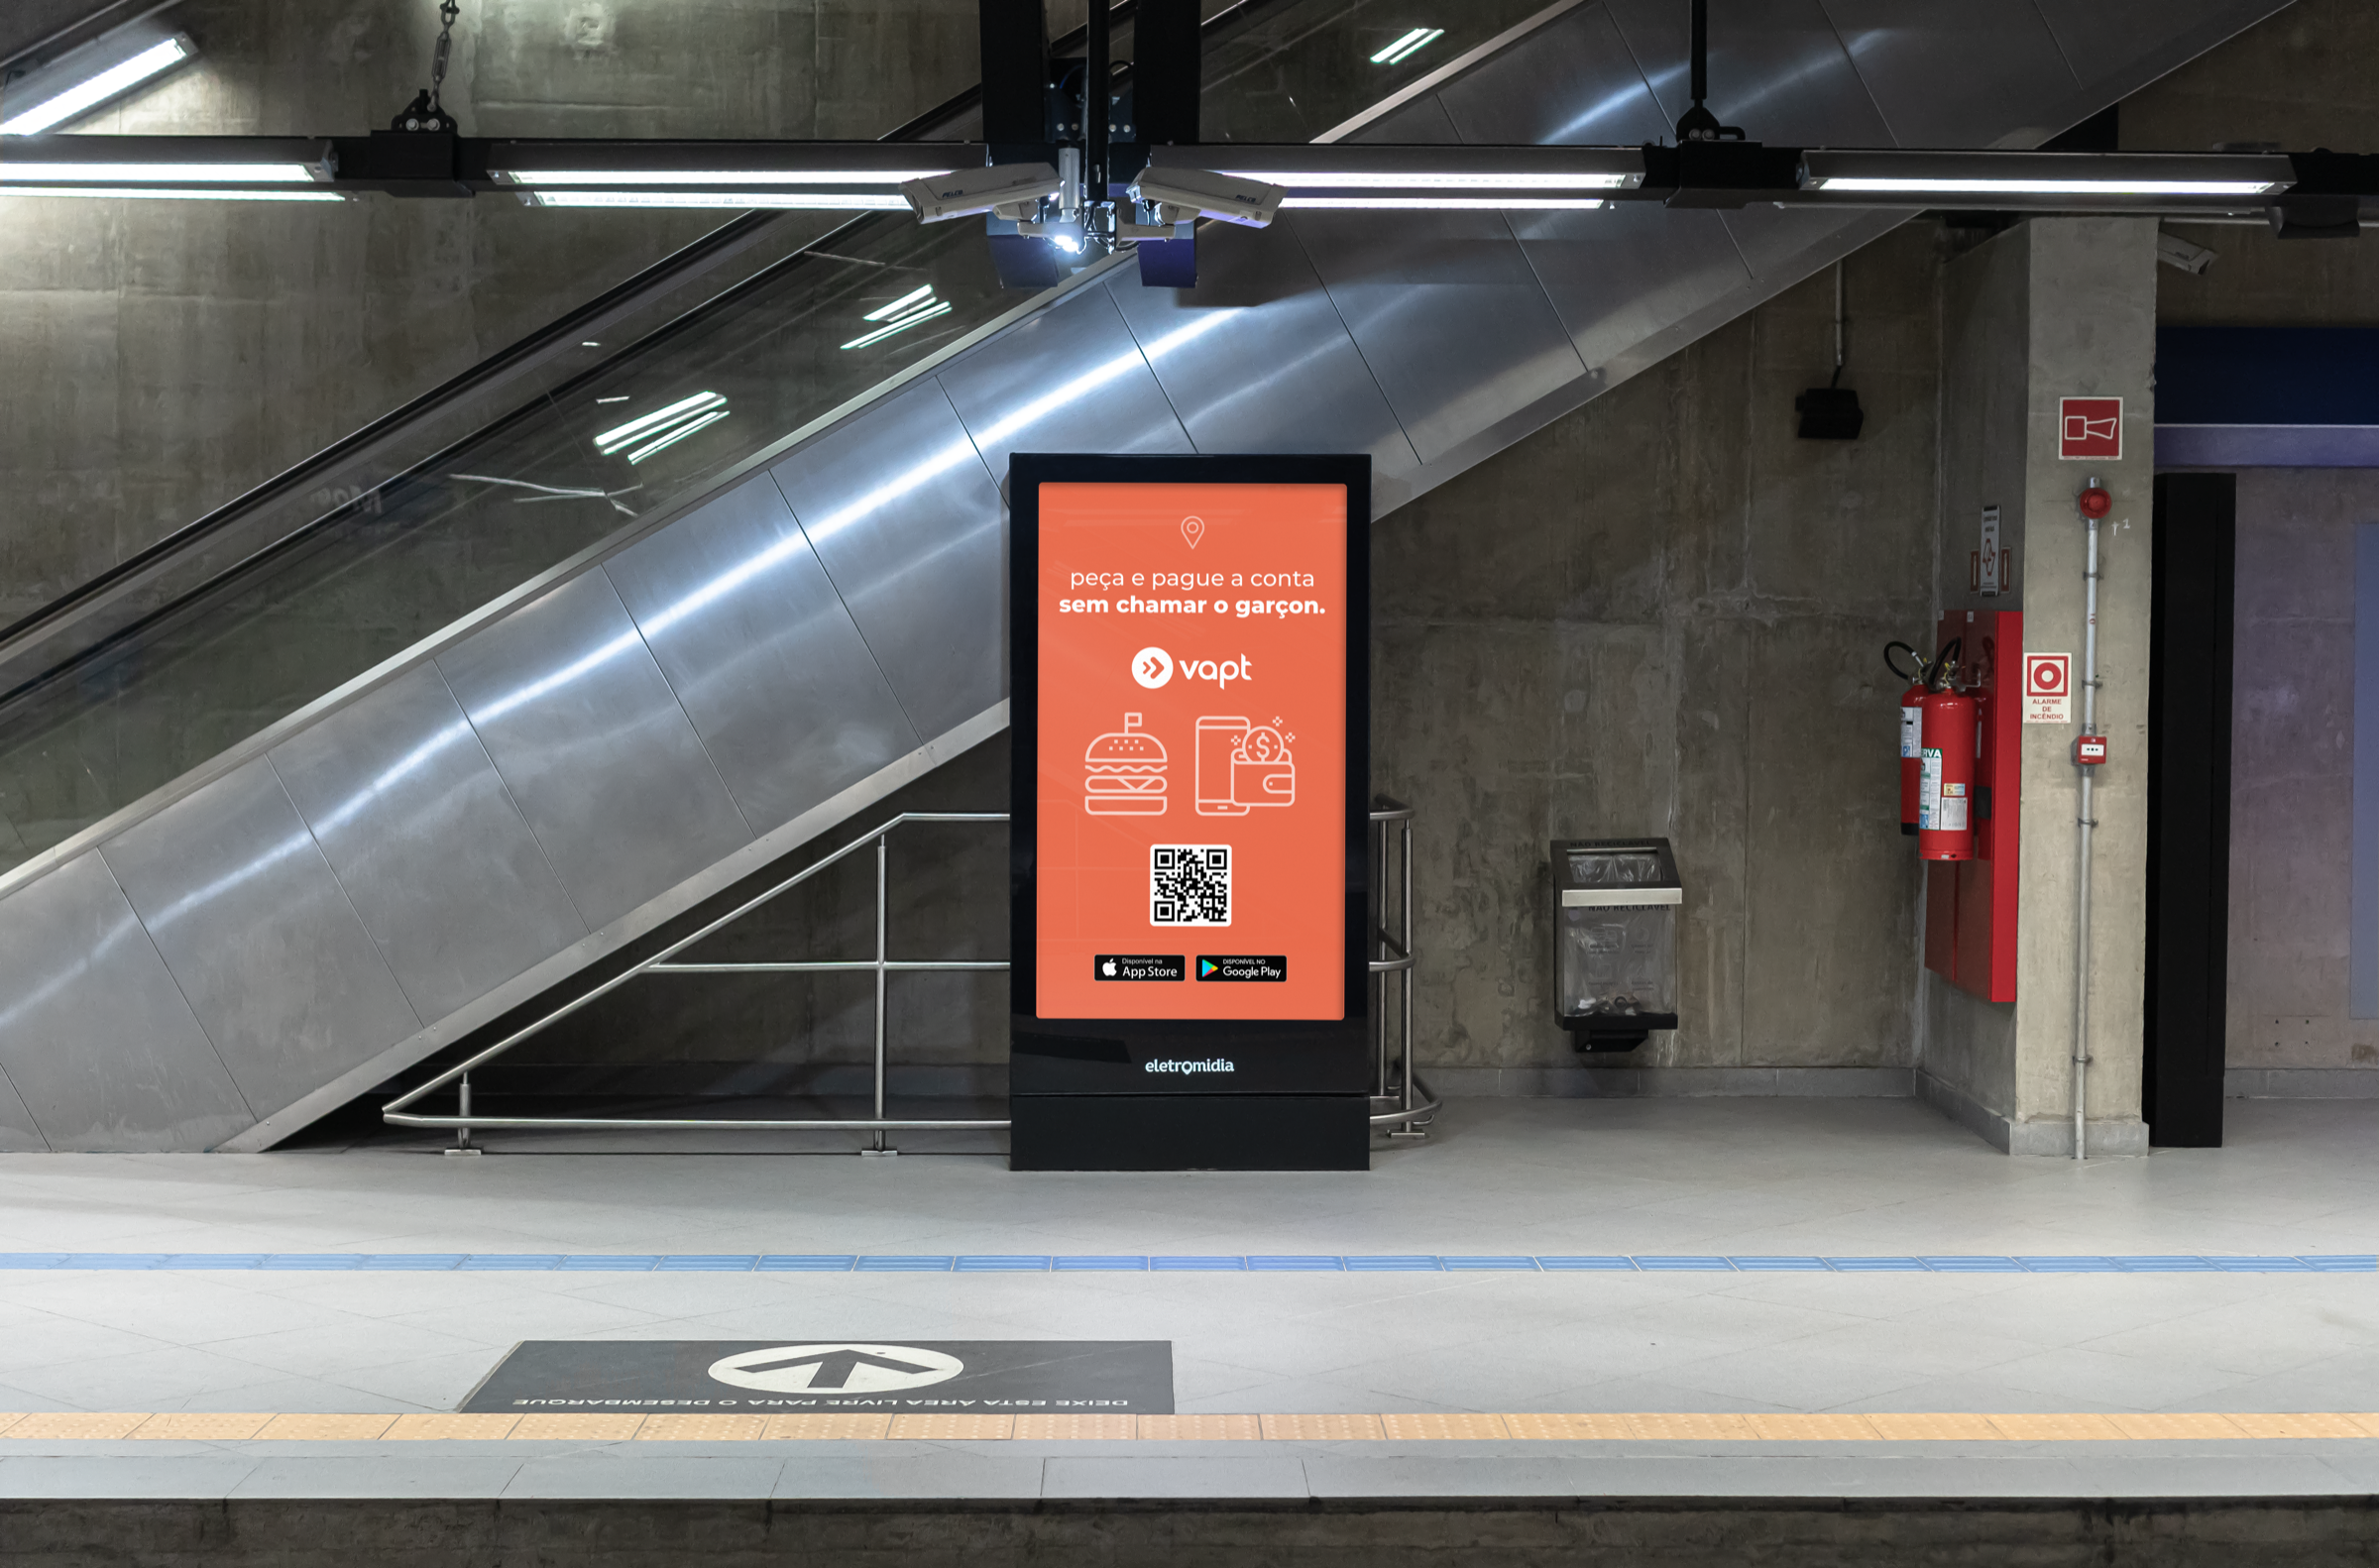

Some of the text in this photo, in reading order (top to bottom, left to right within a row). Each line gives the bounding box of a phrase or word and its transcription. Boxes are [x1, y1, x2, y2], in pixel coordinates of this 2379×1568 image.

[942, 189, 963, 198] PELCO
[1071, 571, 1314, 592] peça e pague a conta
[1059, 595, 1326, 619] sem chamar o garçon.
[1179, 652, 1253, 691] vapt
[1122, 965, 1178, 979] App Store
[1222, 965, 1282, 979] Google Play
[1144, 1058, 1235, 1075] eletromidia
